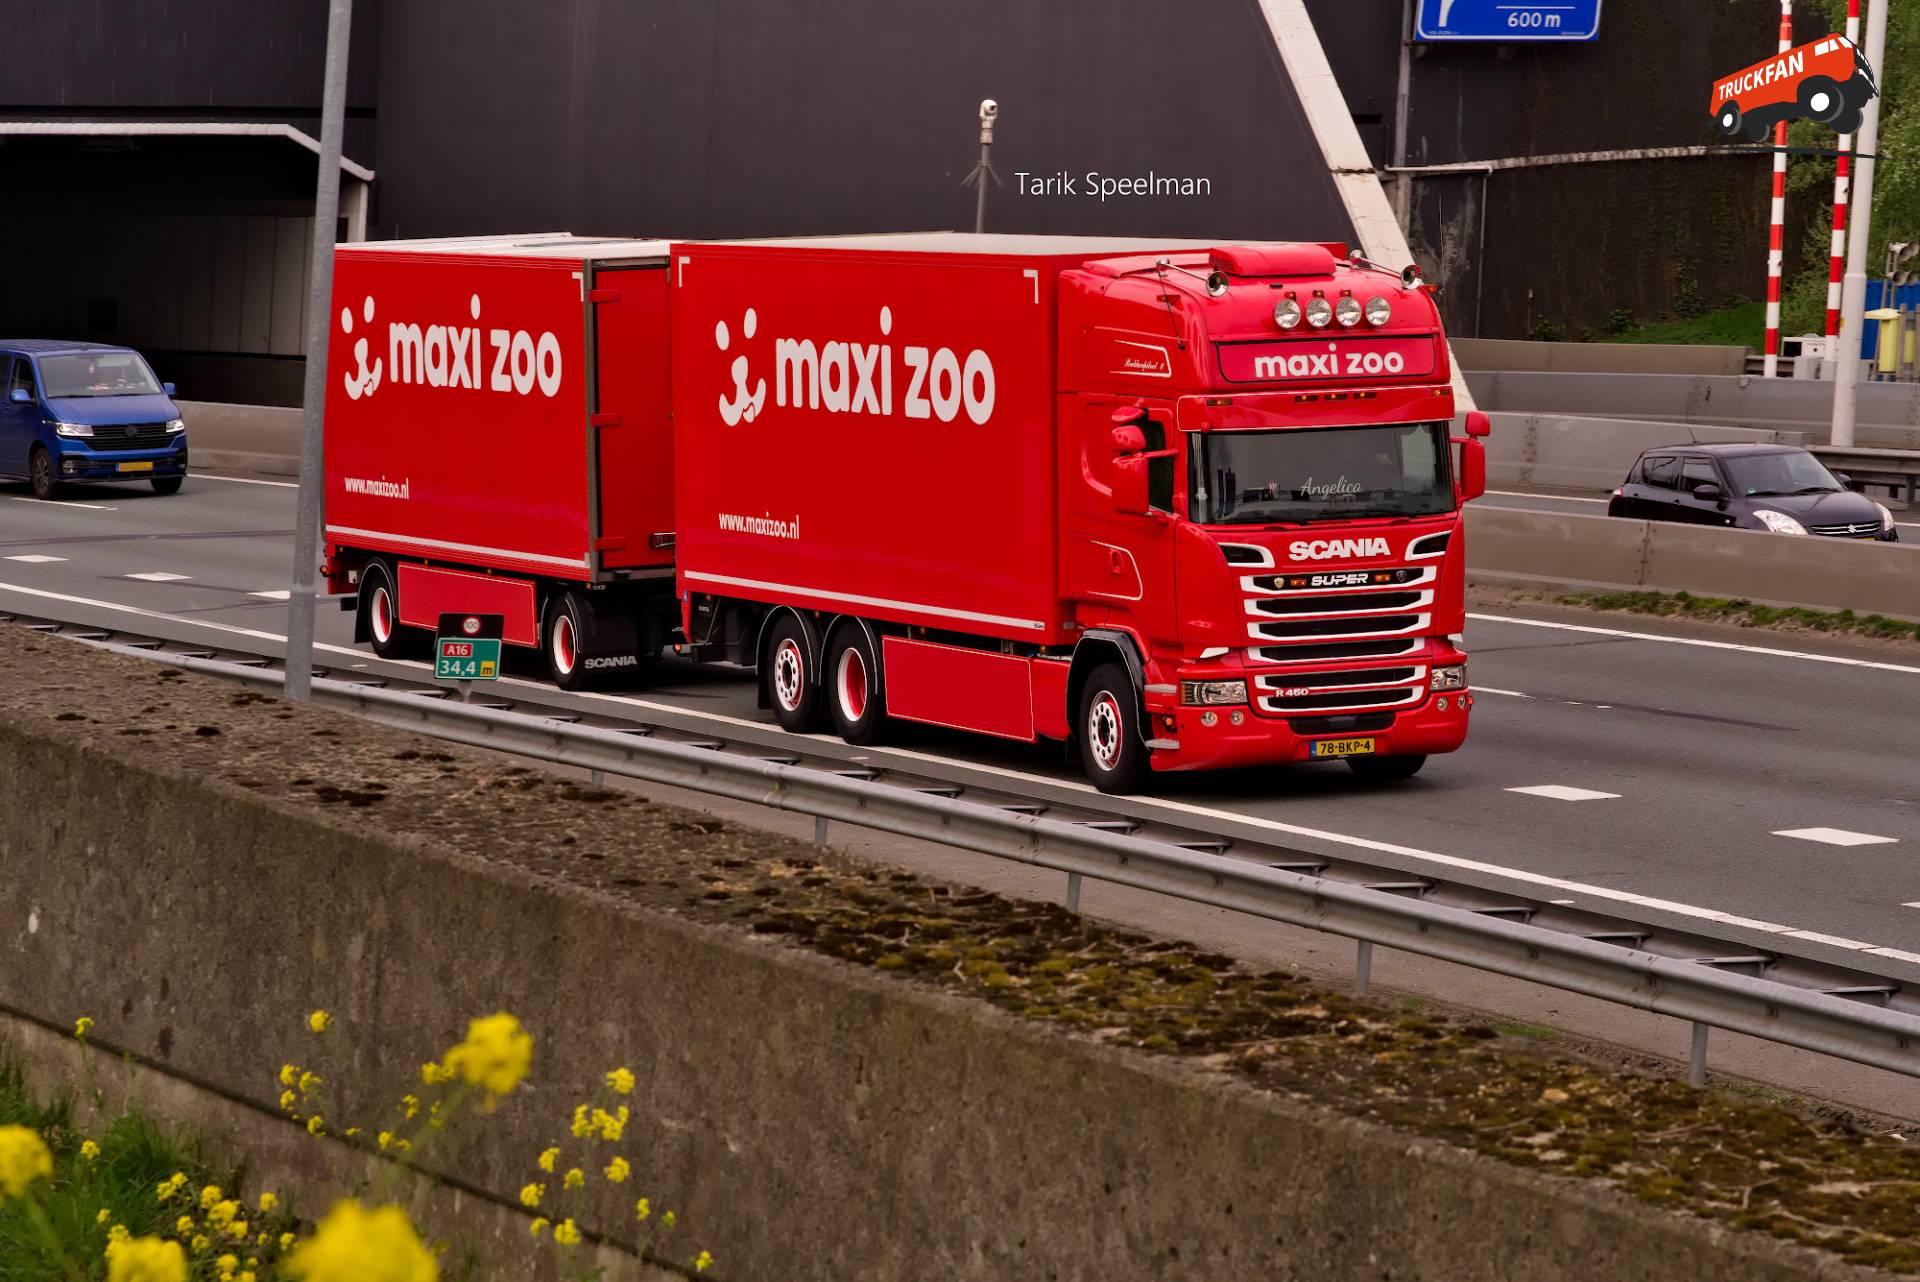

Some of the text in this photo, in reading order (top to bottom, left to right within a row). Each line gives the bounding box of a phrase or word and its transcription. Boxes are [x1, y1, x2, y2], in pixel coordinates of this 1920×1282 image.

[1507, 12, 1561, 28] 600 m
[389, 293, 562, 397] maxi zoo
[775, 305, 996, 425] maxi zoo
[1254, 343, 1404, 378] maxi zoo
[344, 474, 409, 500] www.maxizoo.nl
[1300, 475, 1363, 499] Angelica
[718, 512, 800, 539] www.maxizoo.nl
[1288, 537, 1391, 560] SCANIA
[1310, 573, 1369, 586] SUPER
[447, 645, 469, 656] A16
[440, 660, 476, 676] 34,4
[584, 655, 638, 669] SCANIA
[1275, 687, 1284, 698] R
[1320, 740, 1371, 754] 78-BKP-4
